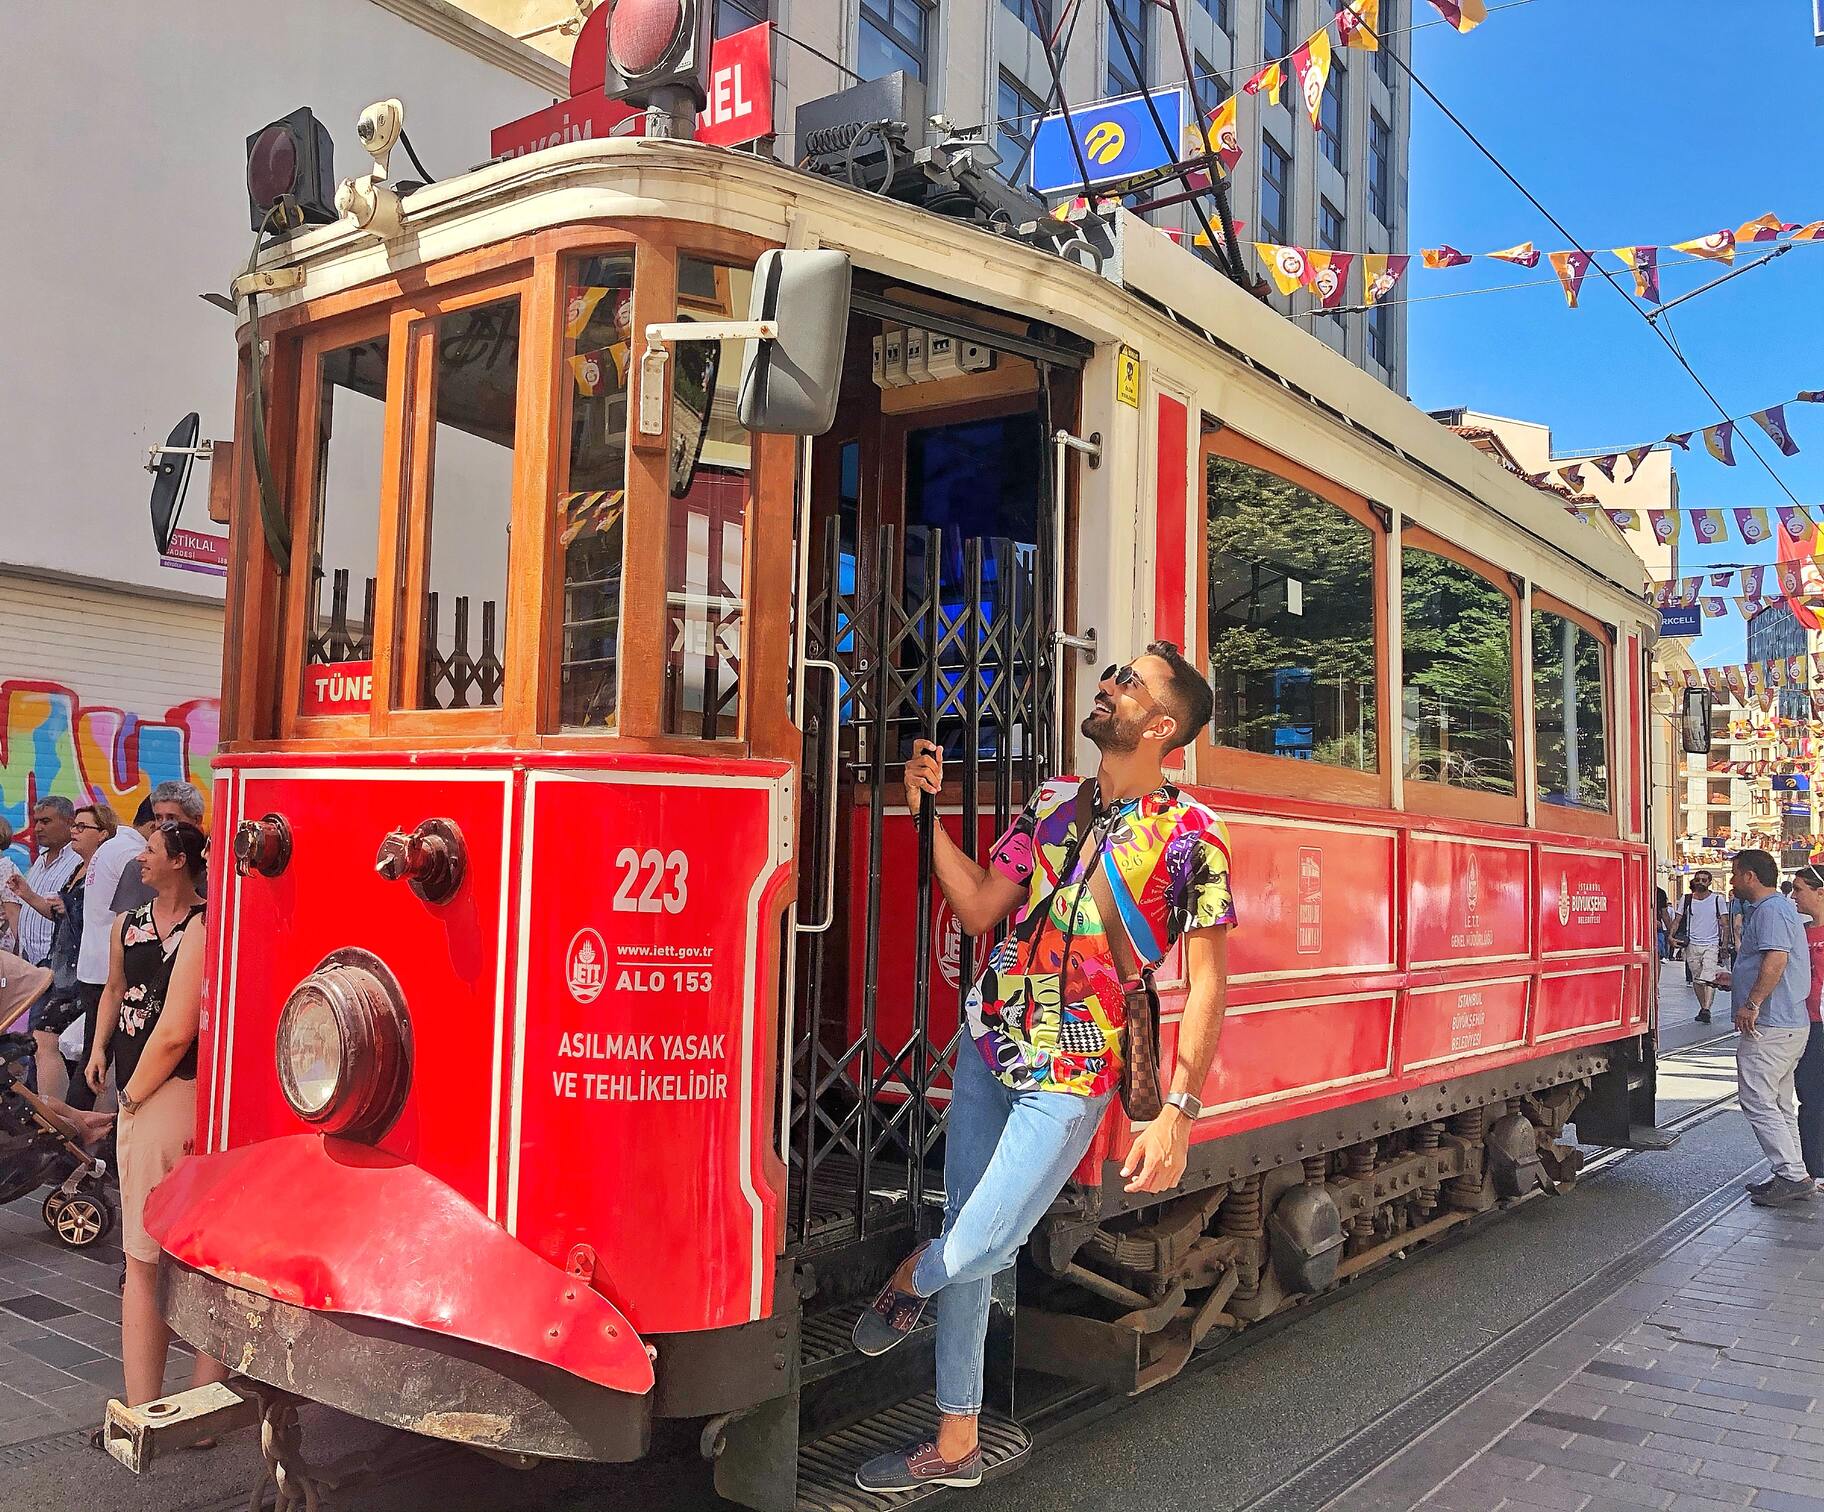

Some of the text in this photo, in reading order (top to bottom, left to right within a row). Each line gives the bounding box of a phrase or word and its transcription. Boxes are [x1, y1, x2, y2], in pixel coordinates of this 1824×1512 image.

[171, 534, 216, 553] STİKLAL
[1661, 616, 1696, 625] RKCELL
[315, 673, 372, 702] TÜNE
[613, 848, 689, 914] 223
[617, 944, 714, 960] www.iett.gov.tr
[616, 970, 713, 992] ALO 153
[558, 1032, 726, 1061] ASILMAK YASAK
[553, 1068, 729, 1101] VE TEHLİKELİDİR
